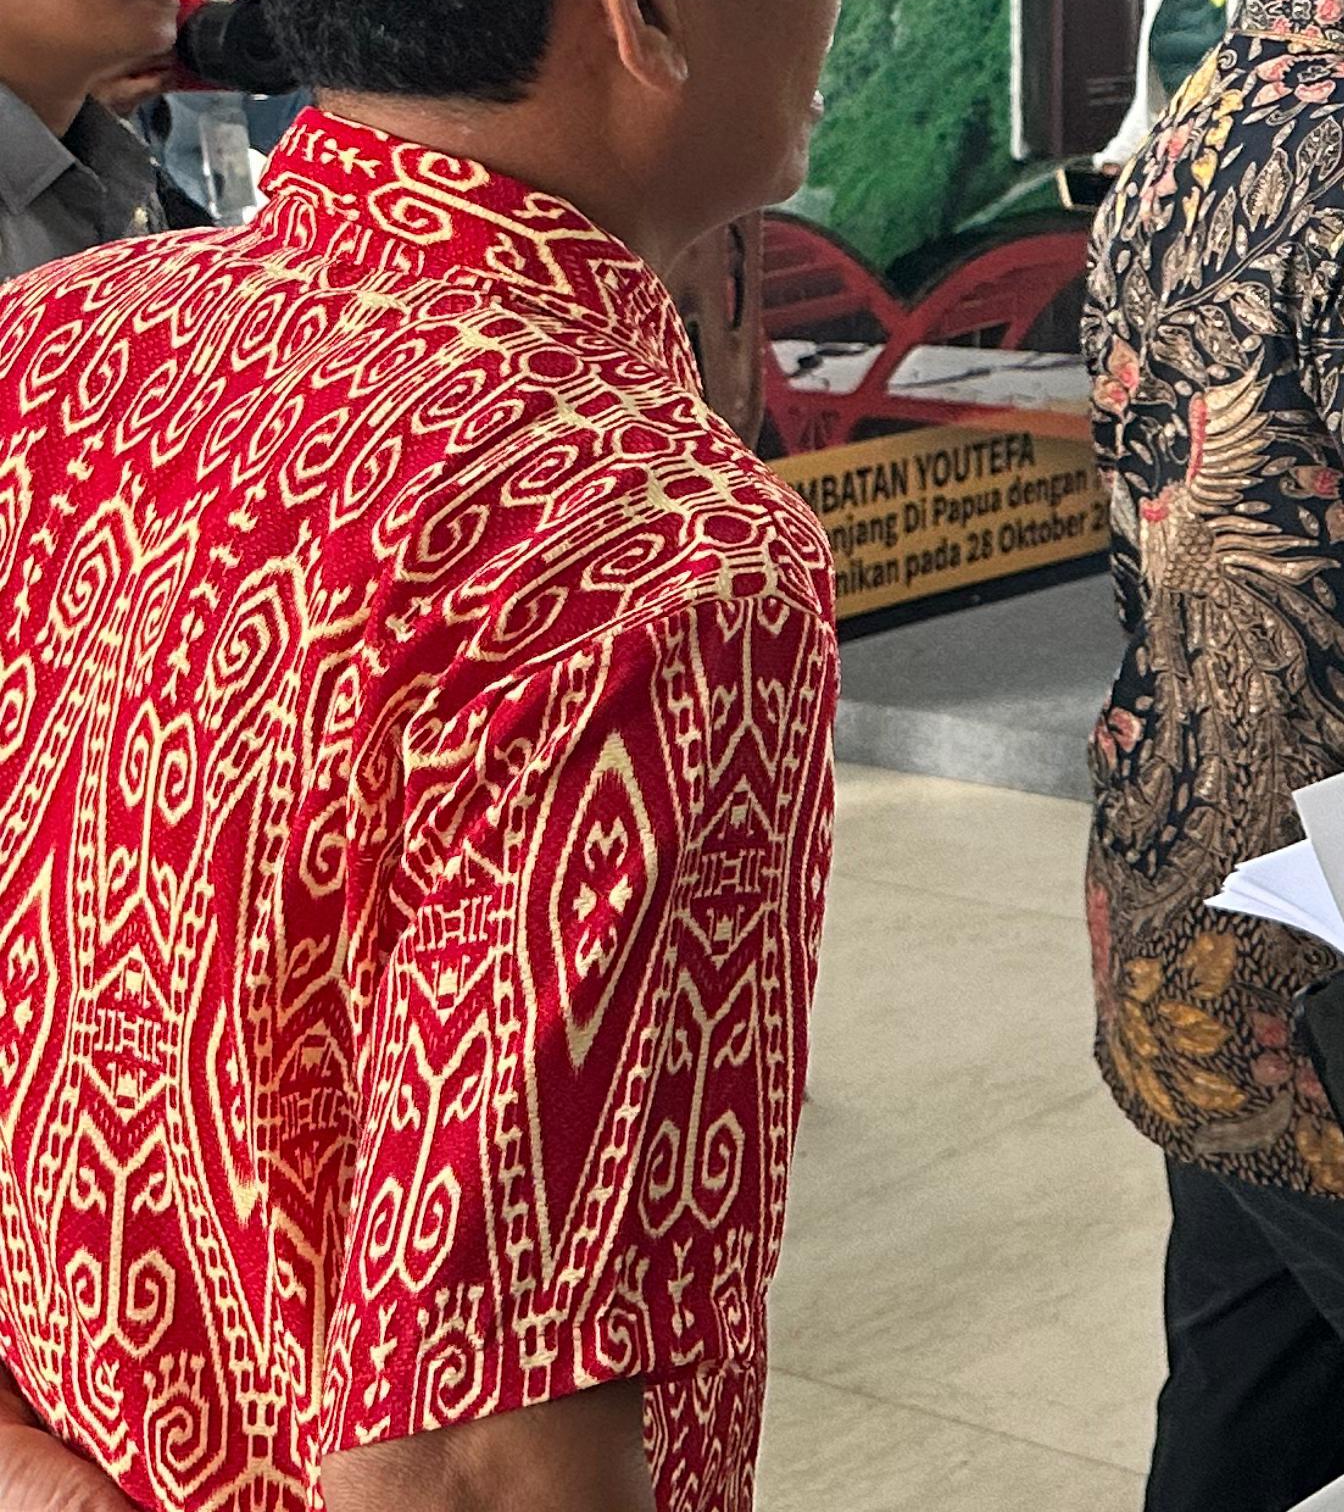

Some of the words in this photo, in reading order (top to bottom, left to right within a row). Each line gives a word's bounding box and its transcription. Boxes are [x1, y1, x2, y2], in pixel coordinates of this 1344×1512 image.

[794, 457, 909, 515] MBATAN
[914, 431, 1035, 491] YOUTEFA
[903, 497, 927, 535] Di
[932, 487, 1003, 529] Papua
[1007, 469, 1089, 509] dengan
[905, 539, 962, 588] pada
[998, 510, 1087, 554] Oktober
